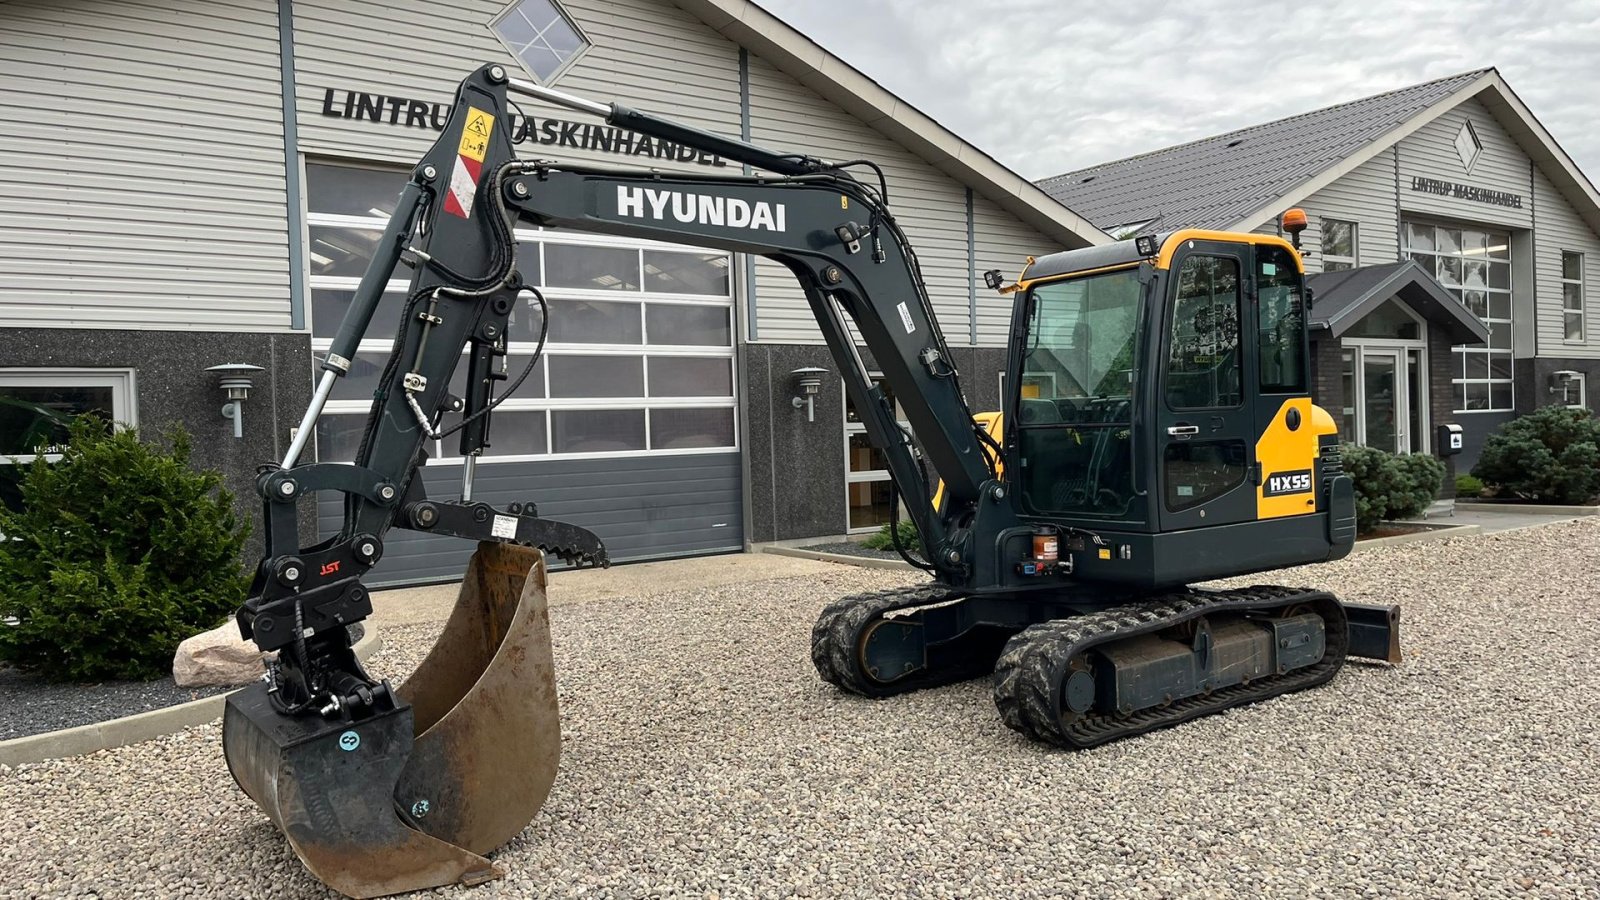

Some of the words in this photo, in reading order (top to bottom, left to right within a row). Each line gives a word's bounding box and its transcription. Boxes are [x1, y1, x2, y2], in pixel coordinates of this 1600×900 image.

[322, 88, 455, 132] LINTRU
[616, 185, 786, 233] HYUNDAI
[1412, 176, 1452, 196] LINTRUP
[1454, 183, 1523, 209] MASKINHANDEL
[1270, 474, 1310, 492] HX55
